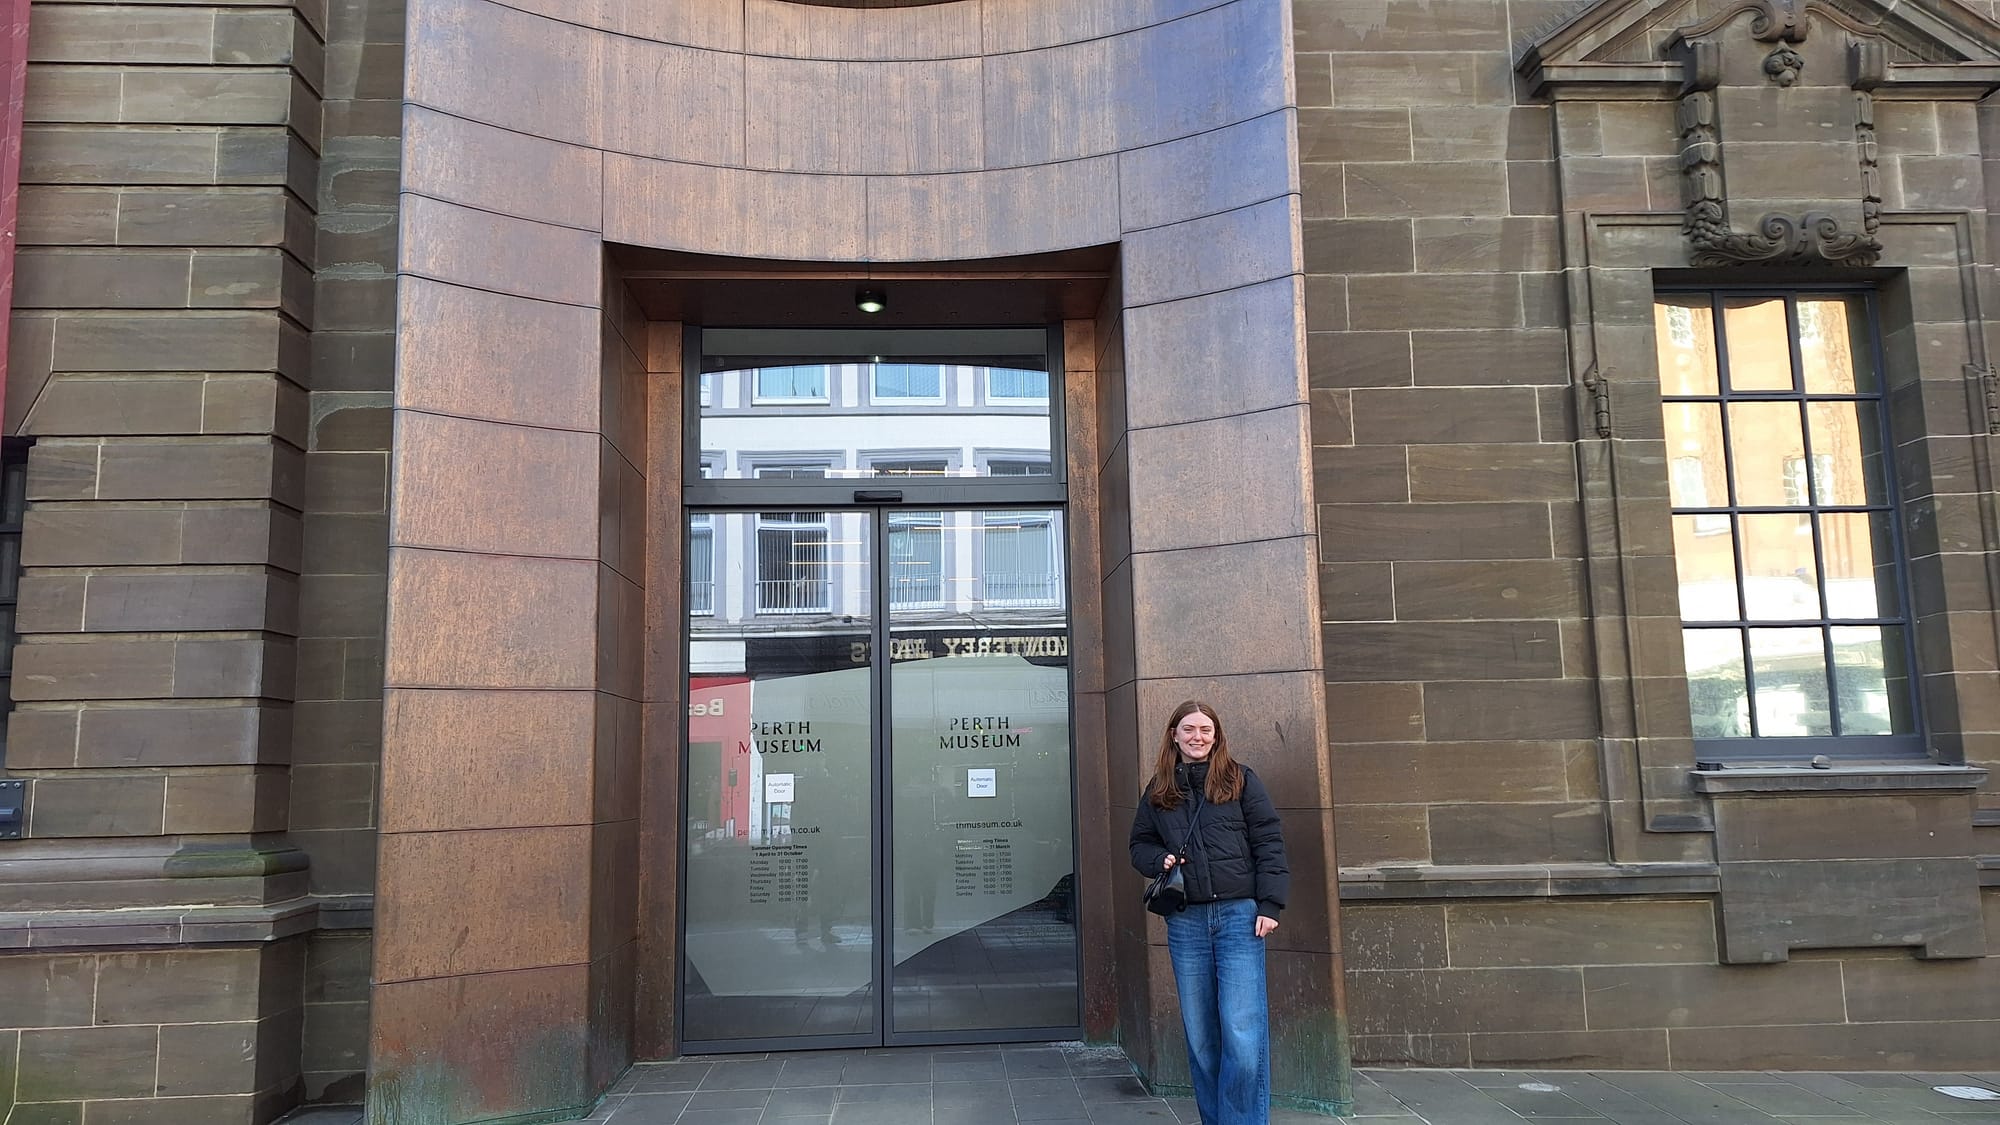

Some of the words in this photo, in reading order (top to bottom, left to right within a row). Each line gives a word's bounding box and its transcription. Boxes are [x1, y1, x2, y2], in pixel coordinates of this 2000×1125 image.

[750, 721, 811, 736] PERTH
[950, 716, 1010, 731] PERTH
[738, 739, 822, 754] MUSEUM
[940, 733, 1021, 749] MUSEUM
